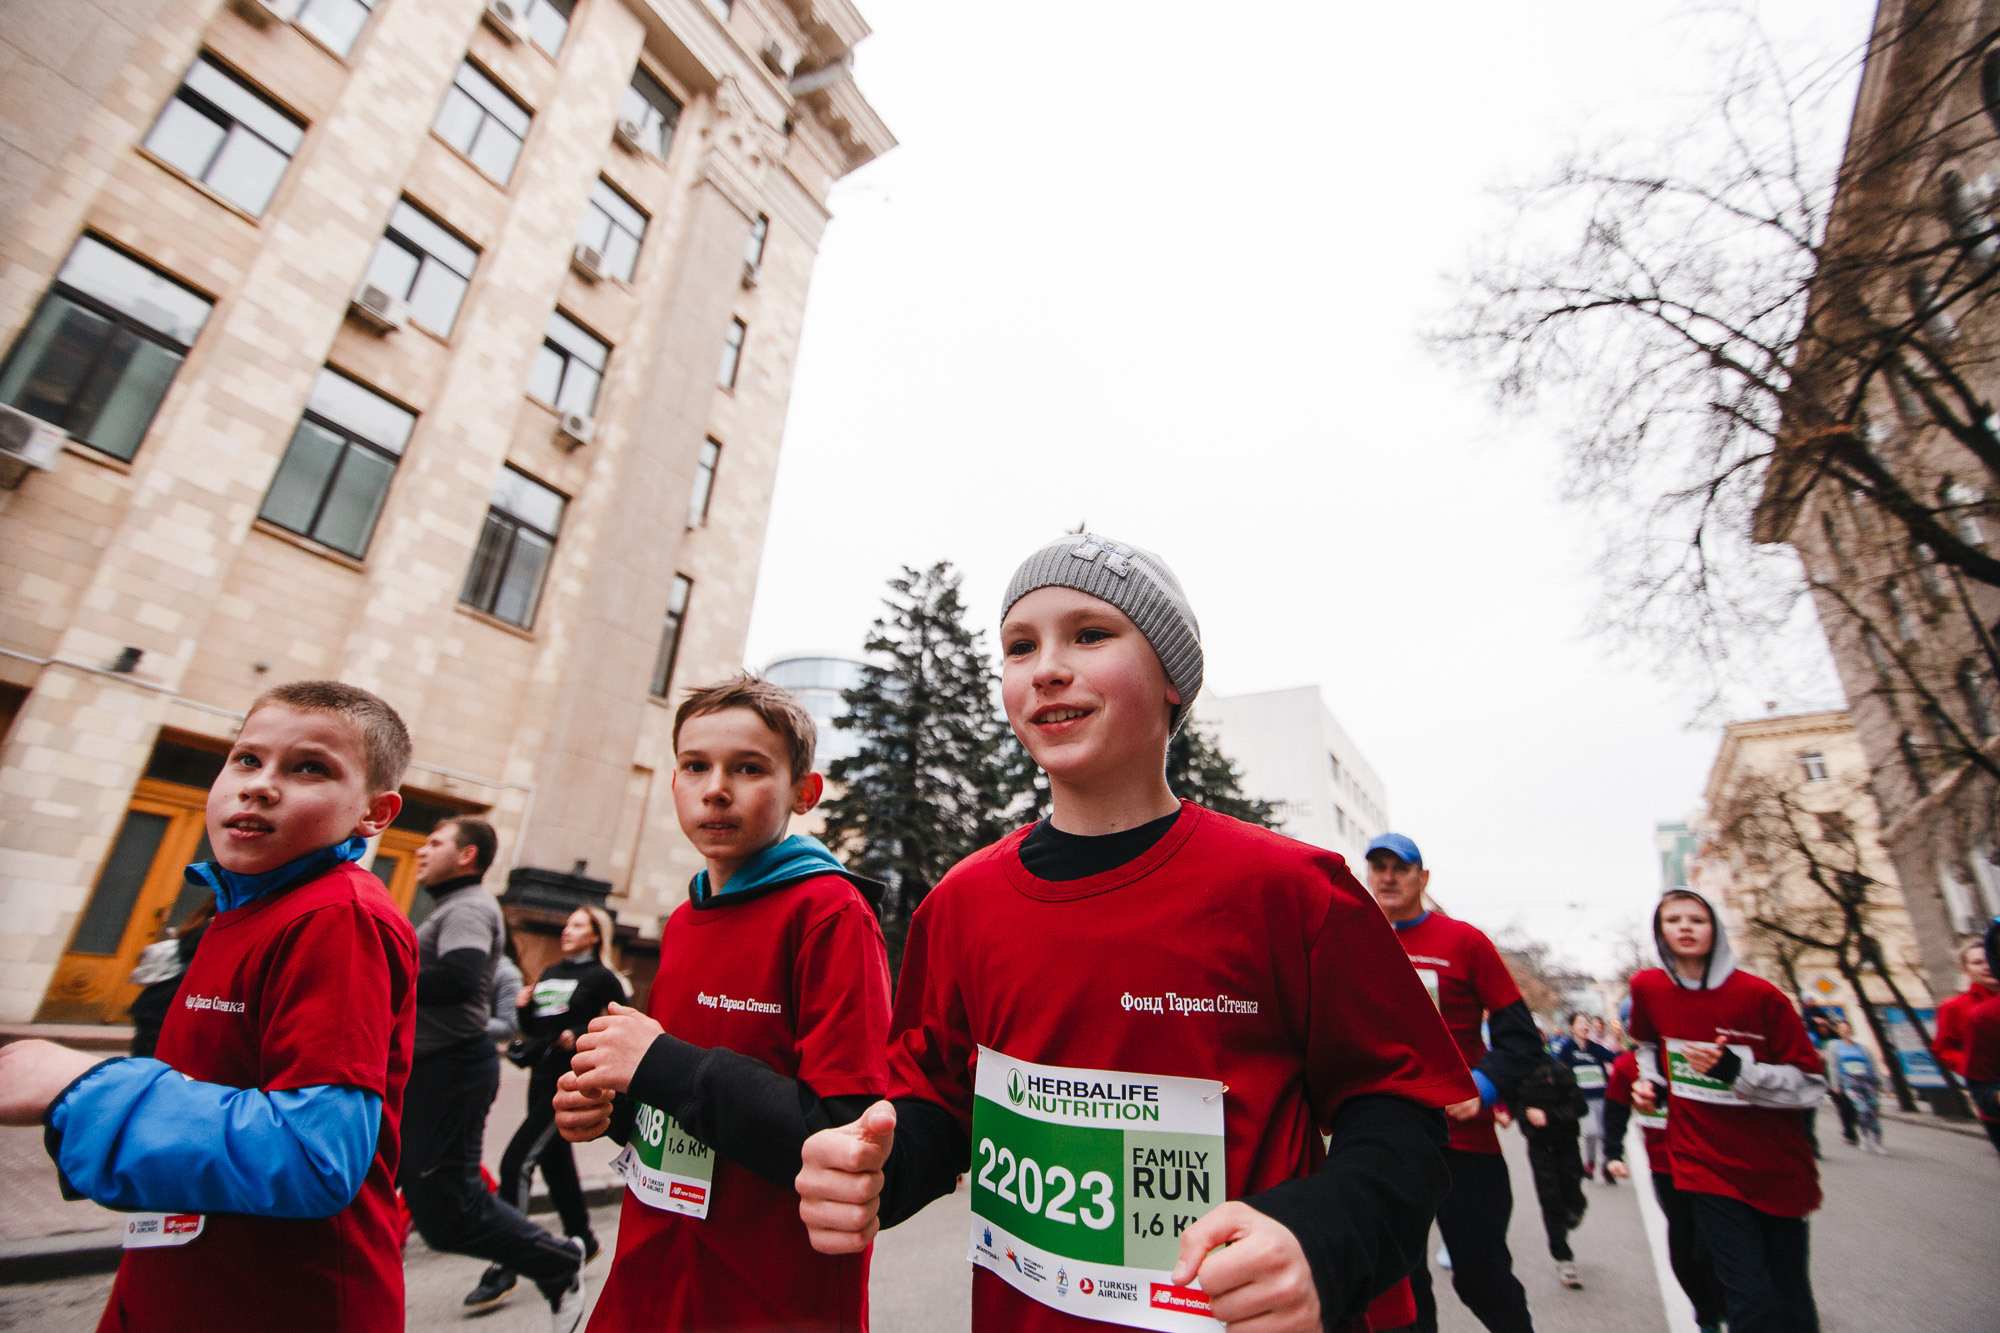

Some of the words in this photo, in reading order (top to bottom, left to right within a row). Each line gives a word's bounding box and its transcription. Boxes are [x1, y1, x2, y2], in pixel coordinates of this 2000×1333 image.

[697, 991, 718, 1009] Фонд
[719, 994, 745, 1012] Тараса
[746, 998, 781, 1013] Сітенка
[1120, 992, 1163, 1015] Фонд
[1166, 992, 1214, 1016] Тараса
[1217, 995, 1259, 1014] Сітенка
[1028, 1075, 1159, 1102] HERBALIFE
[1028, 1093, 1159, 1121] NUTRITION
[668, 1137, 684, 1154] 1,6
[688, 1140, 708, 1158] KM
[1132, 1147, 1209, 1170] FAMILY
[646, 1185, 664, 1193] AIRLINES
[647, 1177, 665, 1187] TURKISH
[978, 1137, 1115, 1230] 22023
[1133, 1166, 1210, 1204] RUN
[688, 1191, 705, 1200] balance
[1132, 1211, 1164, 1239] 1,6
[1174, 1214, 1199, 1238] K
[1098, 1280, 1137, 1292] TURKISH
[1098, 1289, 1138, 1301] AIRLINES
[1170, 1297, 1185, 1306] new
[1185, 1298, 1211, 1310] balanc
